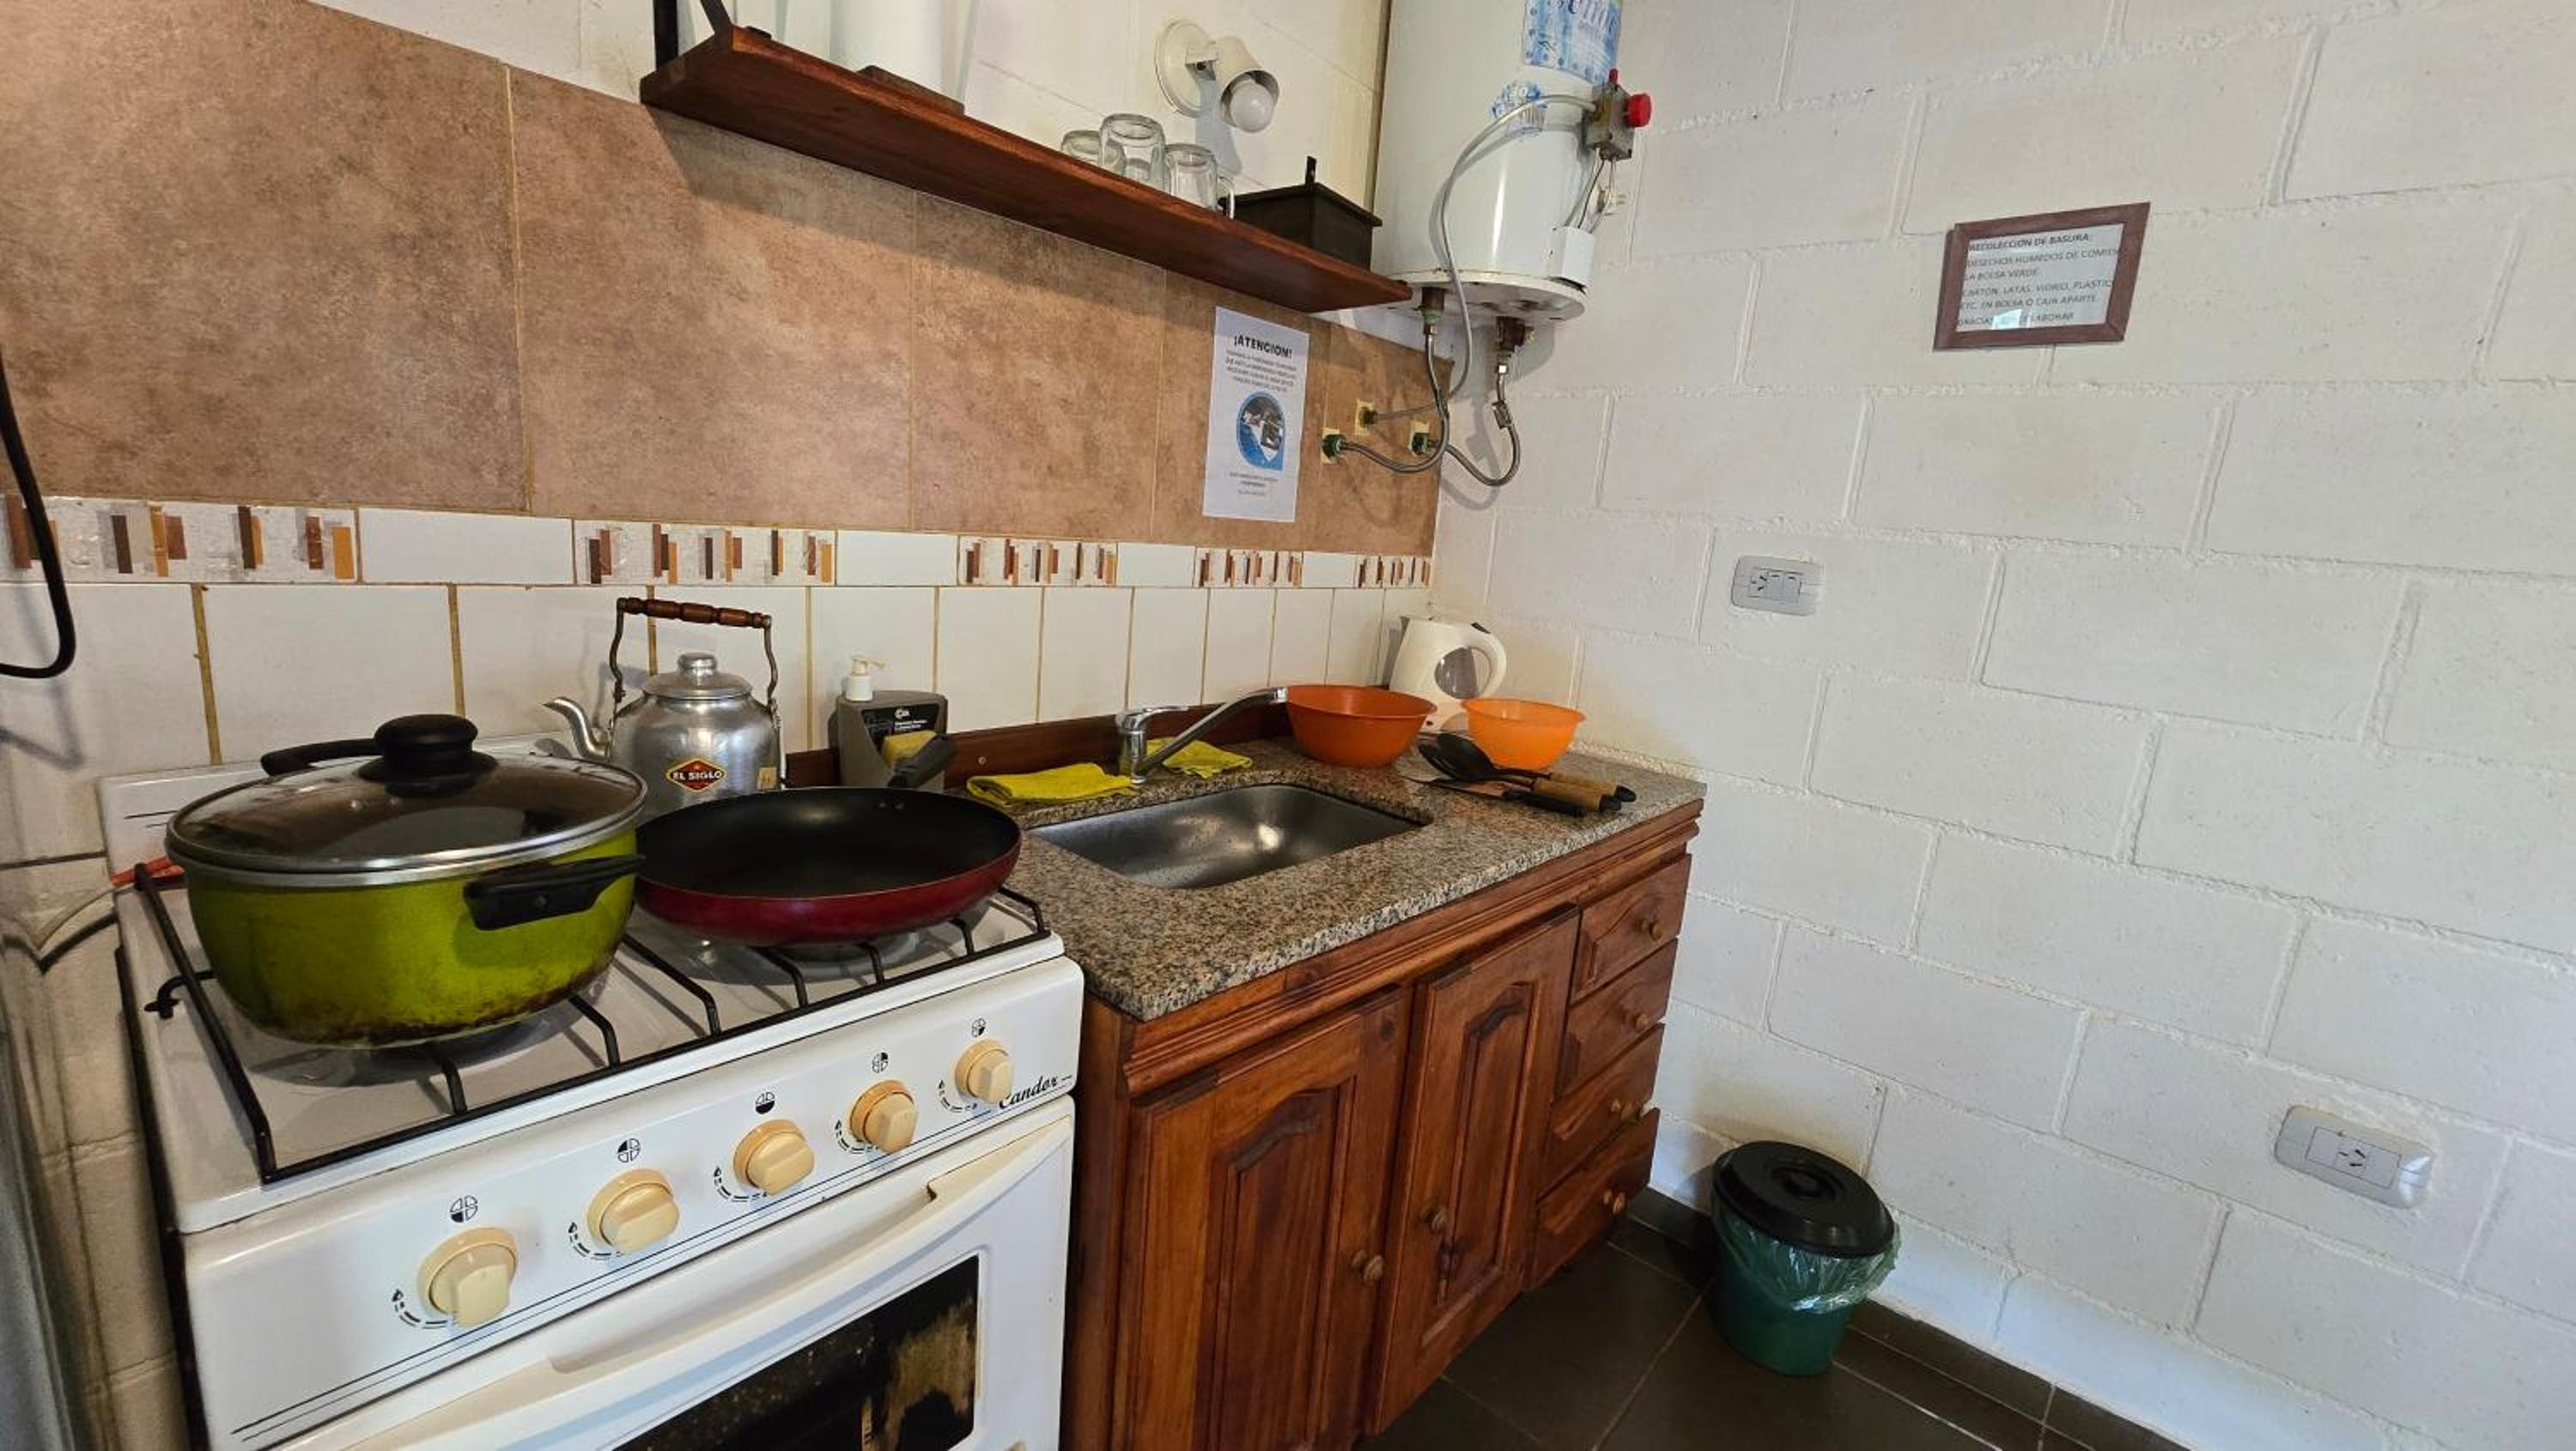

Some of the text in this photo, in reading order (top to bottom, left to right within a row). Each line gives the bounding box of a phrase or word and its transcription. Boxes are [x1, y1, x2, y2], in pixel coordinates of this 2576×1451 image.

[2034, 237, 2045, 247] DE
[2066, 251, 2078, 260] DE
[688, 770, 722, 780] SIGLO
